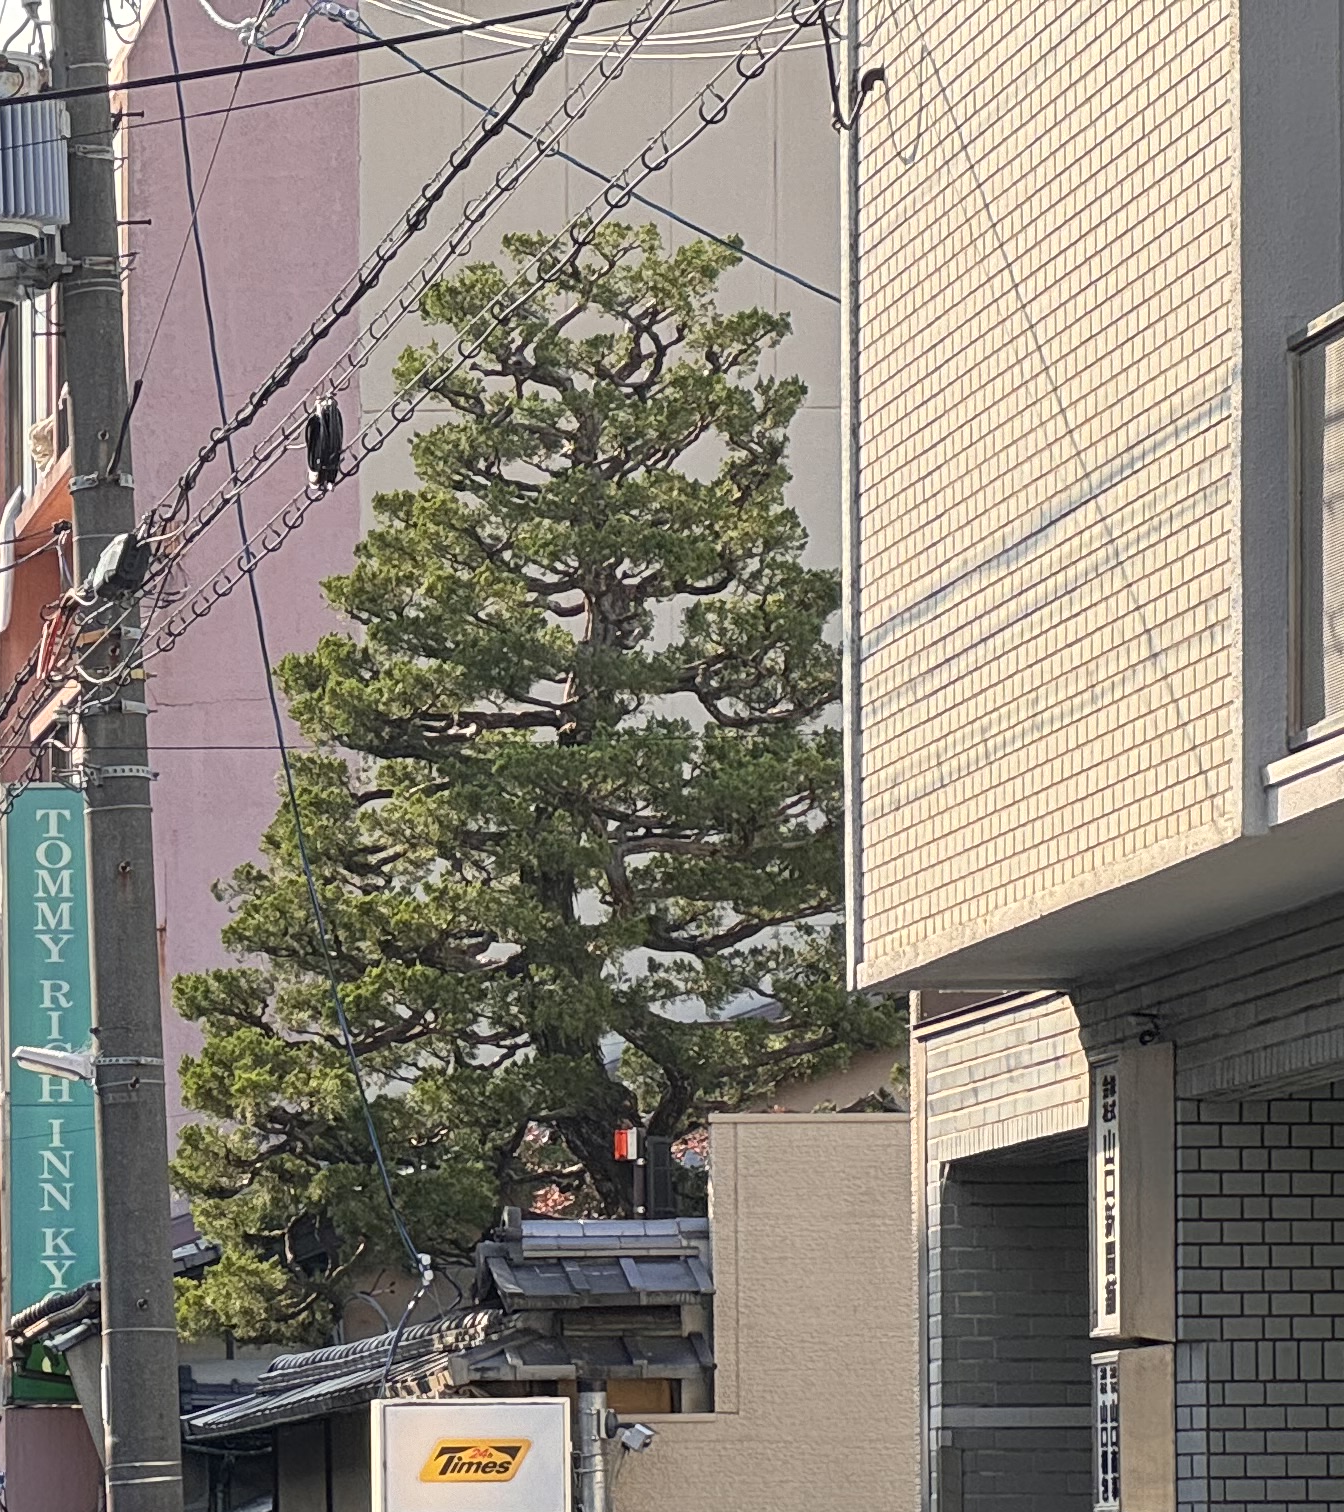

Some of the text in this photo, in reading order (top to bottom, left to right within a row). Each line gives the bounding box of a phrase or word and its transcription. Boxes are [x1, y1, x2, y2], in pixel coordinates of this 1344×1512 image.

[33, 808, 77, 1304] TOMMY RIH INN KY
[434, 1451, 514, 1476] Times
